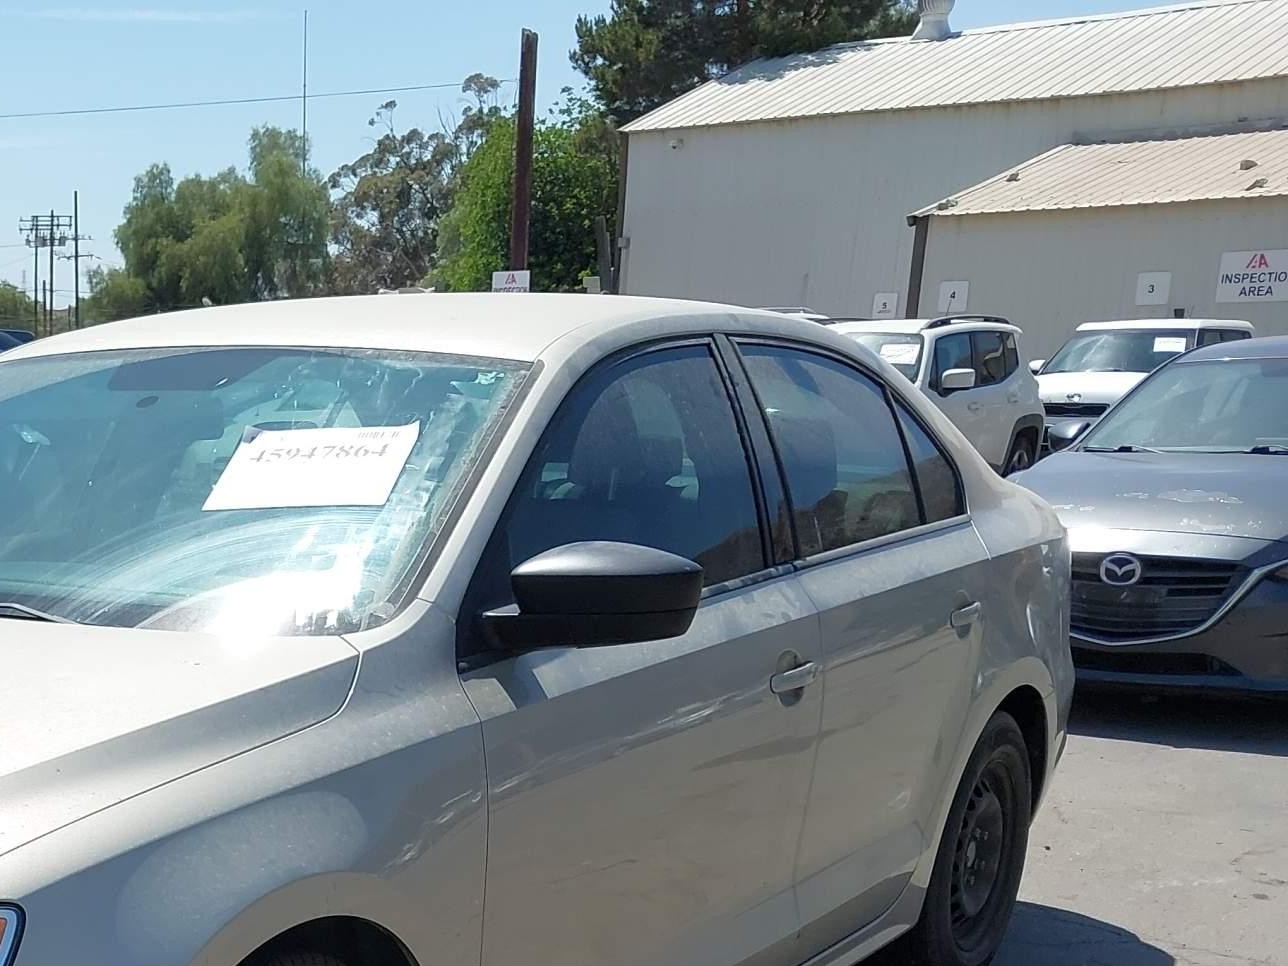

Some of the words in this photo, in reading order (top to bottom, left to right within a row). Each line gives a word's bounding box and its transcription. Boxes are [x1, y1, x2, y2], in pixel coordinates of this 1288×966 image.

[1147, 284, 1155, 293] 3
[1238, 285, 1274, 297] AREA
[950, 291, 956, 299] 4
